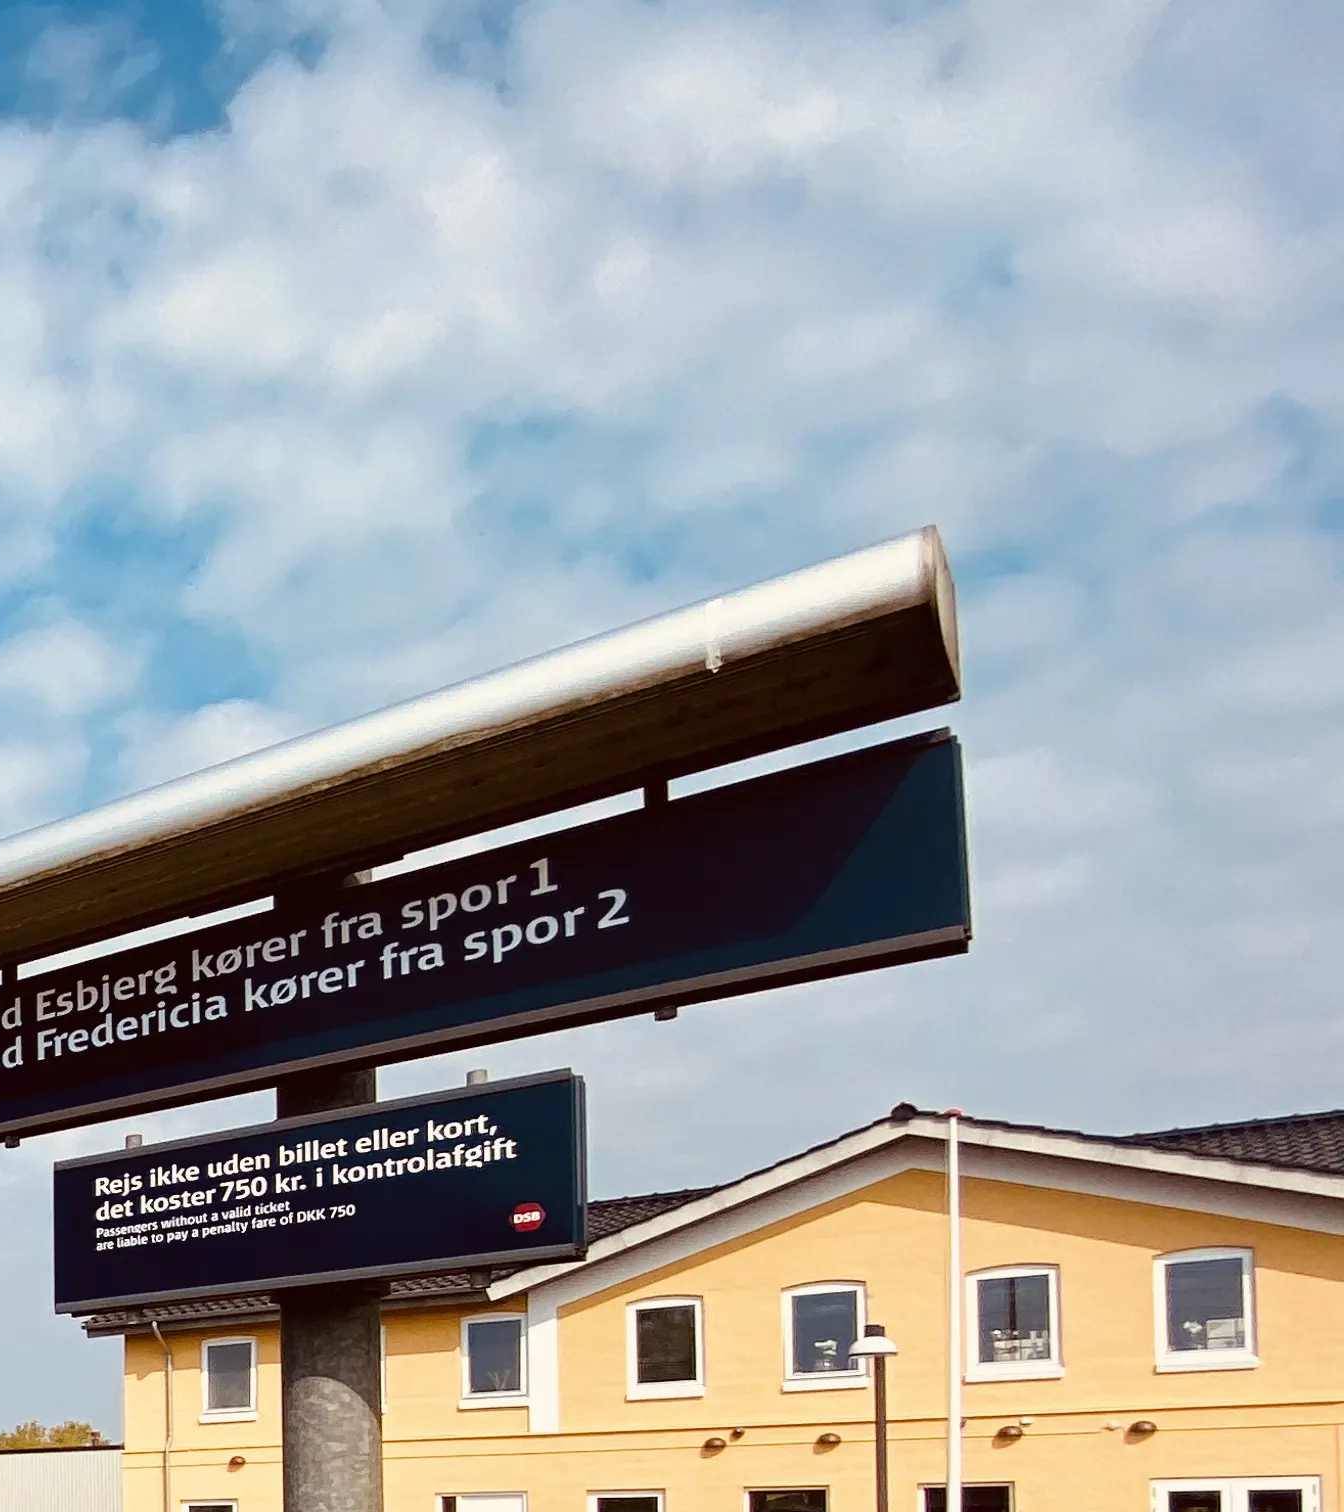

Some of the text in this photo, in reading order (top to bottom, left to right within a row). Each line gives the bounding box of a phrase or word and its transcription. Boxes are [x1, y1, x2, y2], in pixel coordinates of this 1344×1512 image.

[36, 962, 178, 1022] Esbjerg
[192, 929, 307, 982] kører
[321, 912, 384, 948] fra
[401, 874, 518, 932] spor
[529, 857, 559, 897] 1
[37, 992, 228, 1061] Fredericia
[245, 960, 366, 1012] kører
[379, 941, 445, 980] fra
[463, 906, 585, 964] spor
[597, 888, 630, 930] 2
[94, 1114, 498, 1197] Rejs ikke uden billet eller kort,
[95, 1137, 518, 1222] det koster 750 kr. i kontrolafgift
[95, 1200, 291, 1239] Passengers without a valid ticket
[95, 1203, 357, 1251] are liable to pay a penalty fare of DKK 750
[512, 1211, 541, 1225] DSB
